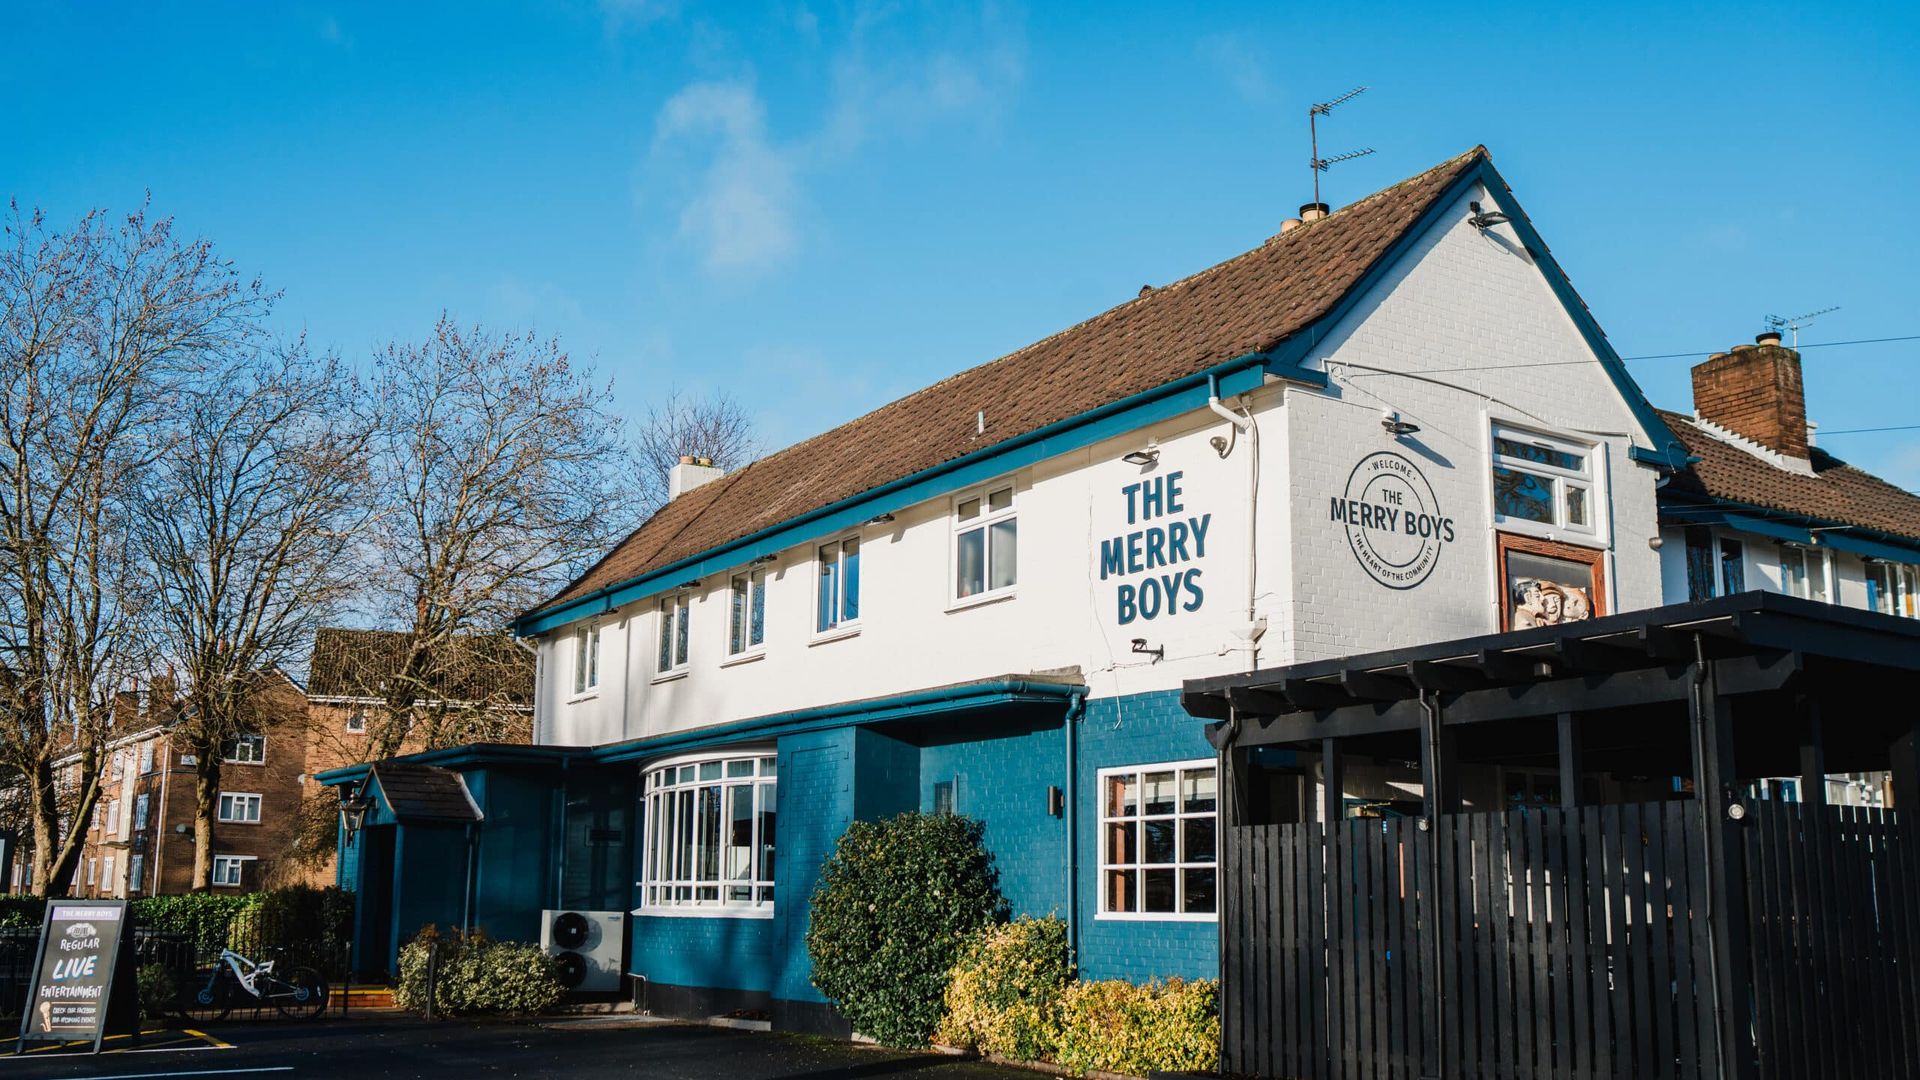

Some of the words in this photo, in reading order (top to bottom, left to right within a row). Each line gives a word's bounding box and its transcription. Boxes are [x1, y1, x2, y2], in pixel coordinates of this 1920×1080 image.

[1372, 459, 1412, 477] WELCOME
[1122, 470, 1184, 525] THE
[1382, 489, 1402, 505] THE
[1331, 497, 1399, 532] MERRY
[1405, 511, 1454, 542] BOYS
[1100, 513, 1211, 580] MERRY
[1354, 533, 1364, 549] THE
[1362, 550, 1381, 573] HEART
[1382, 569, 1391, 579] OF
[1392, 572, 1404, 581] THE
[1405, 545, 1433, 580] COMMUNITY
[1118, 568, 1204, 625] BOYS
[60, 938, 100, 951] REGULAR
[52, 955, 98, 980] LIVE
[41, 985, 103, 998] ENTERTAINMENT
